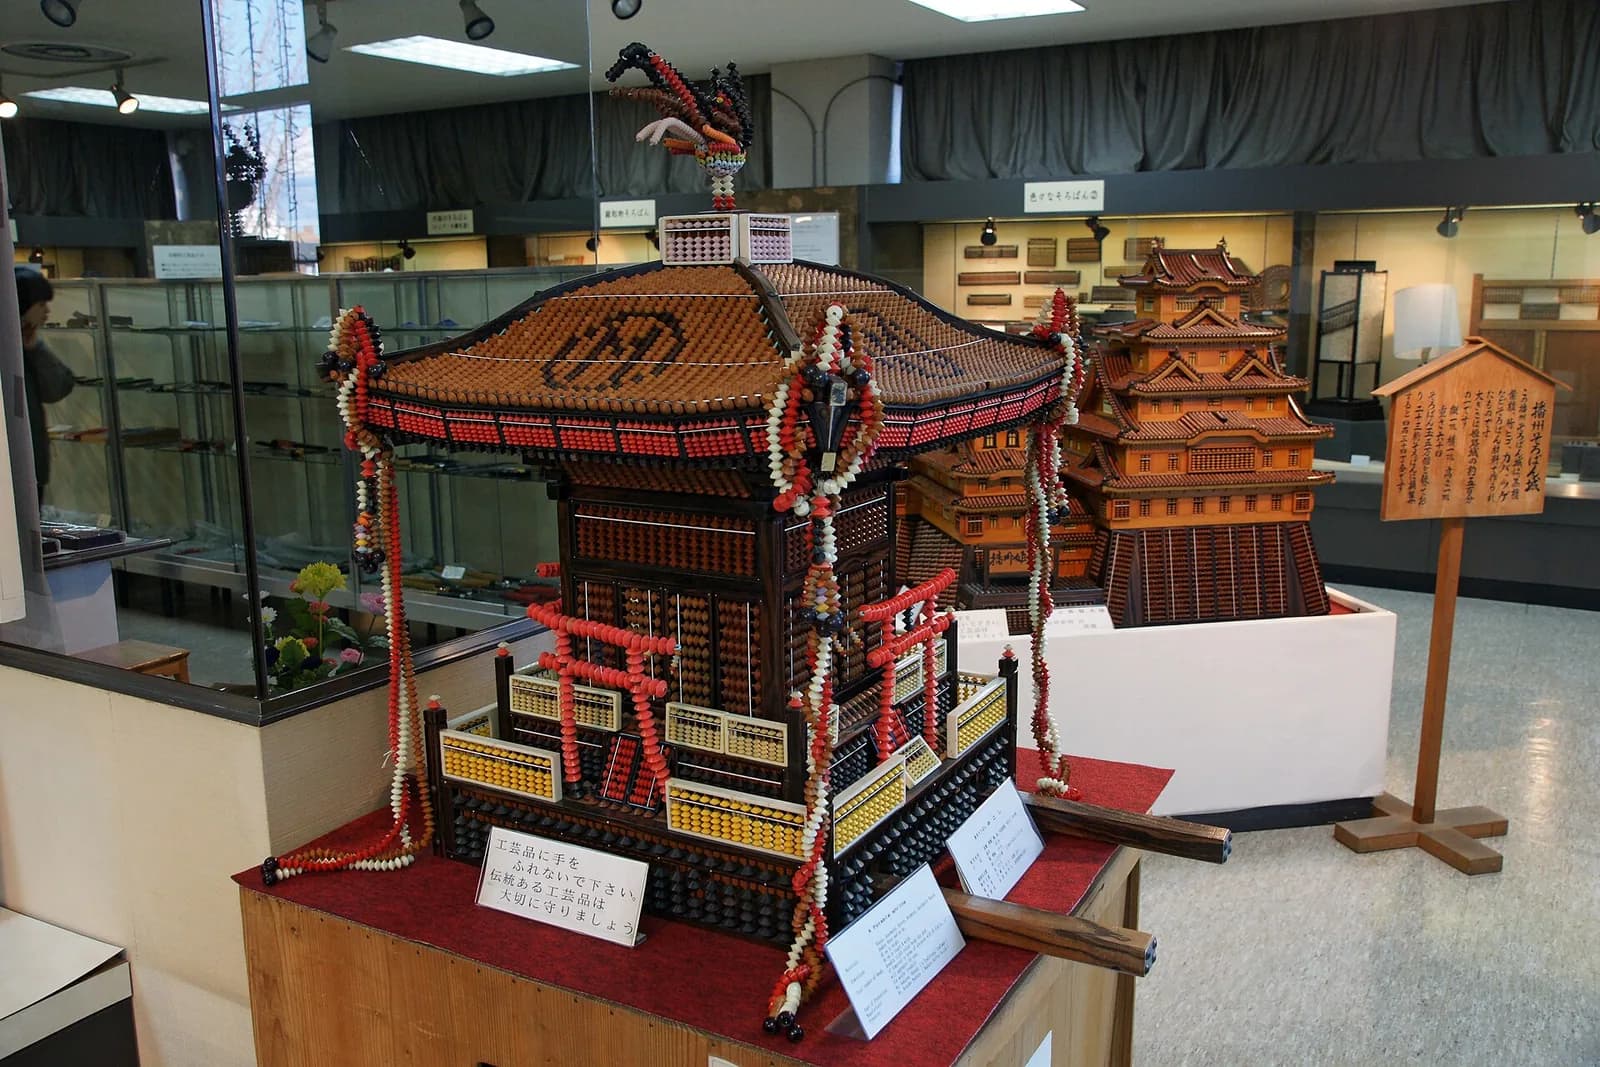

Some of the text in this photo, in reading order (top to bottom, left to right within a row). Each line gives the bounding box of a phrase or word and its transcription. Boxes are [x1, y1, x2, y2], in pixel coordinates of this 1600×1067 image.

[495, 838, 580, 870] 工芸品に手を
[490, 868, 606, 911] 伝統ある工芸品は
[512, 860, 637, 902] ふれないで下さい。
[499, 888, 635, 936] 大切に守りましょう
